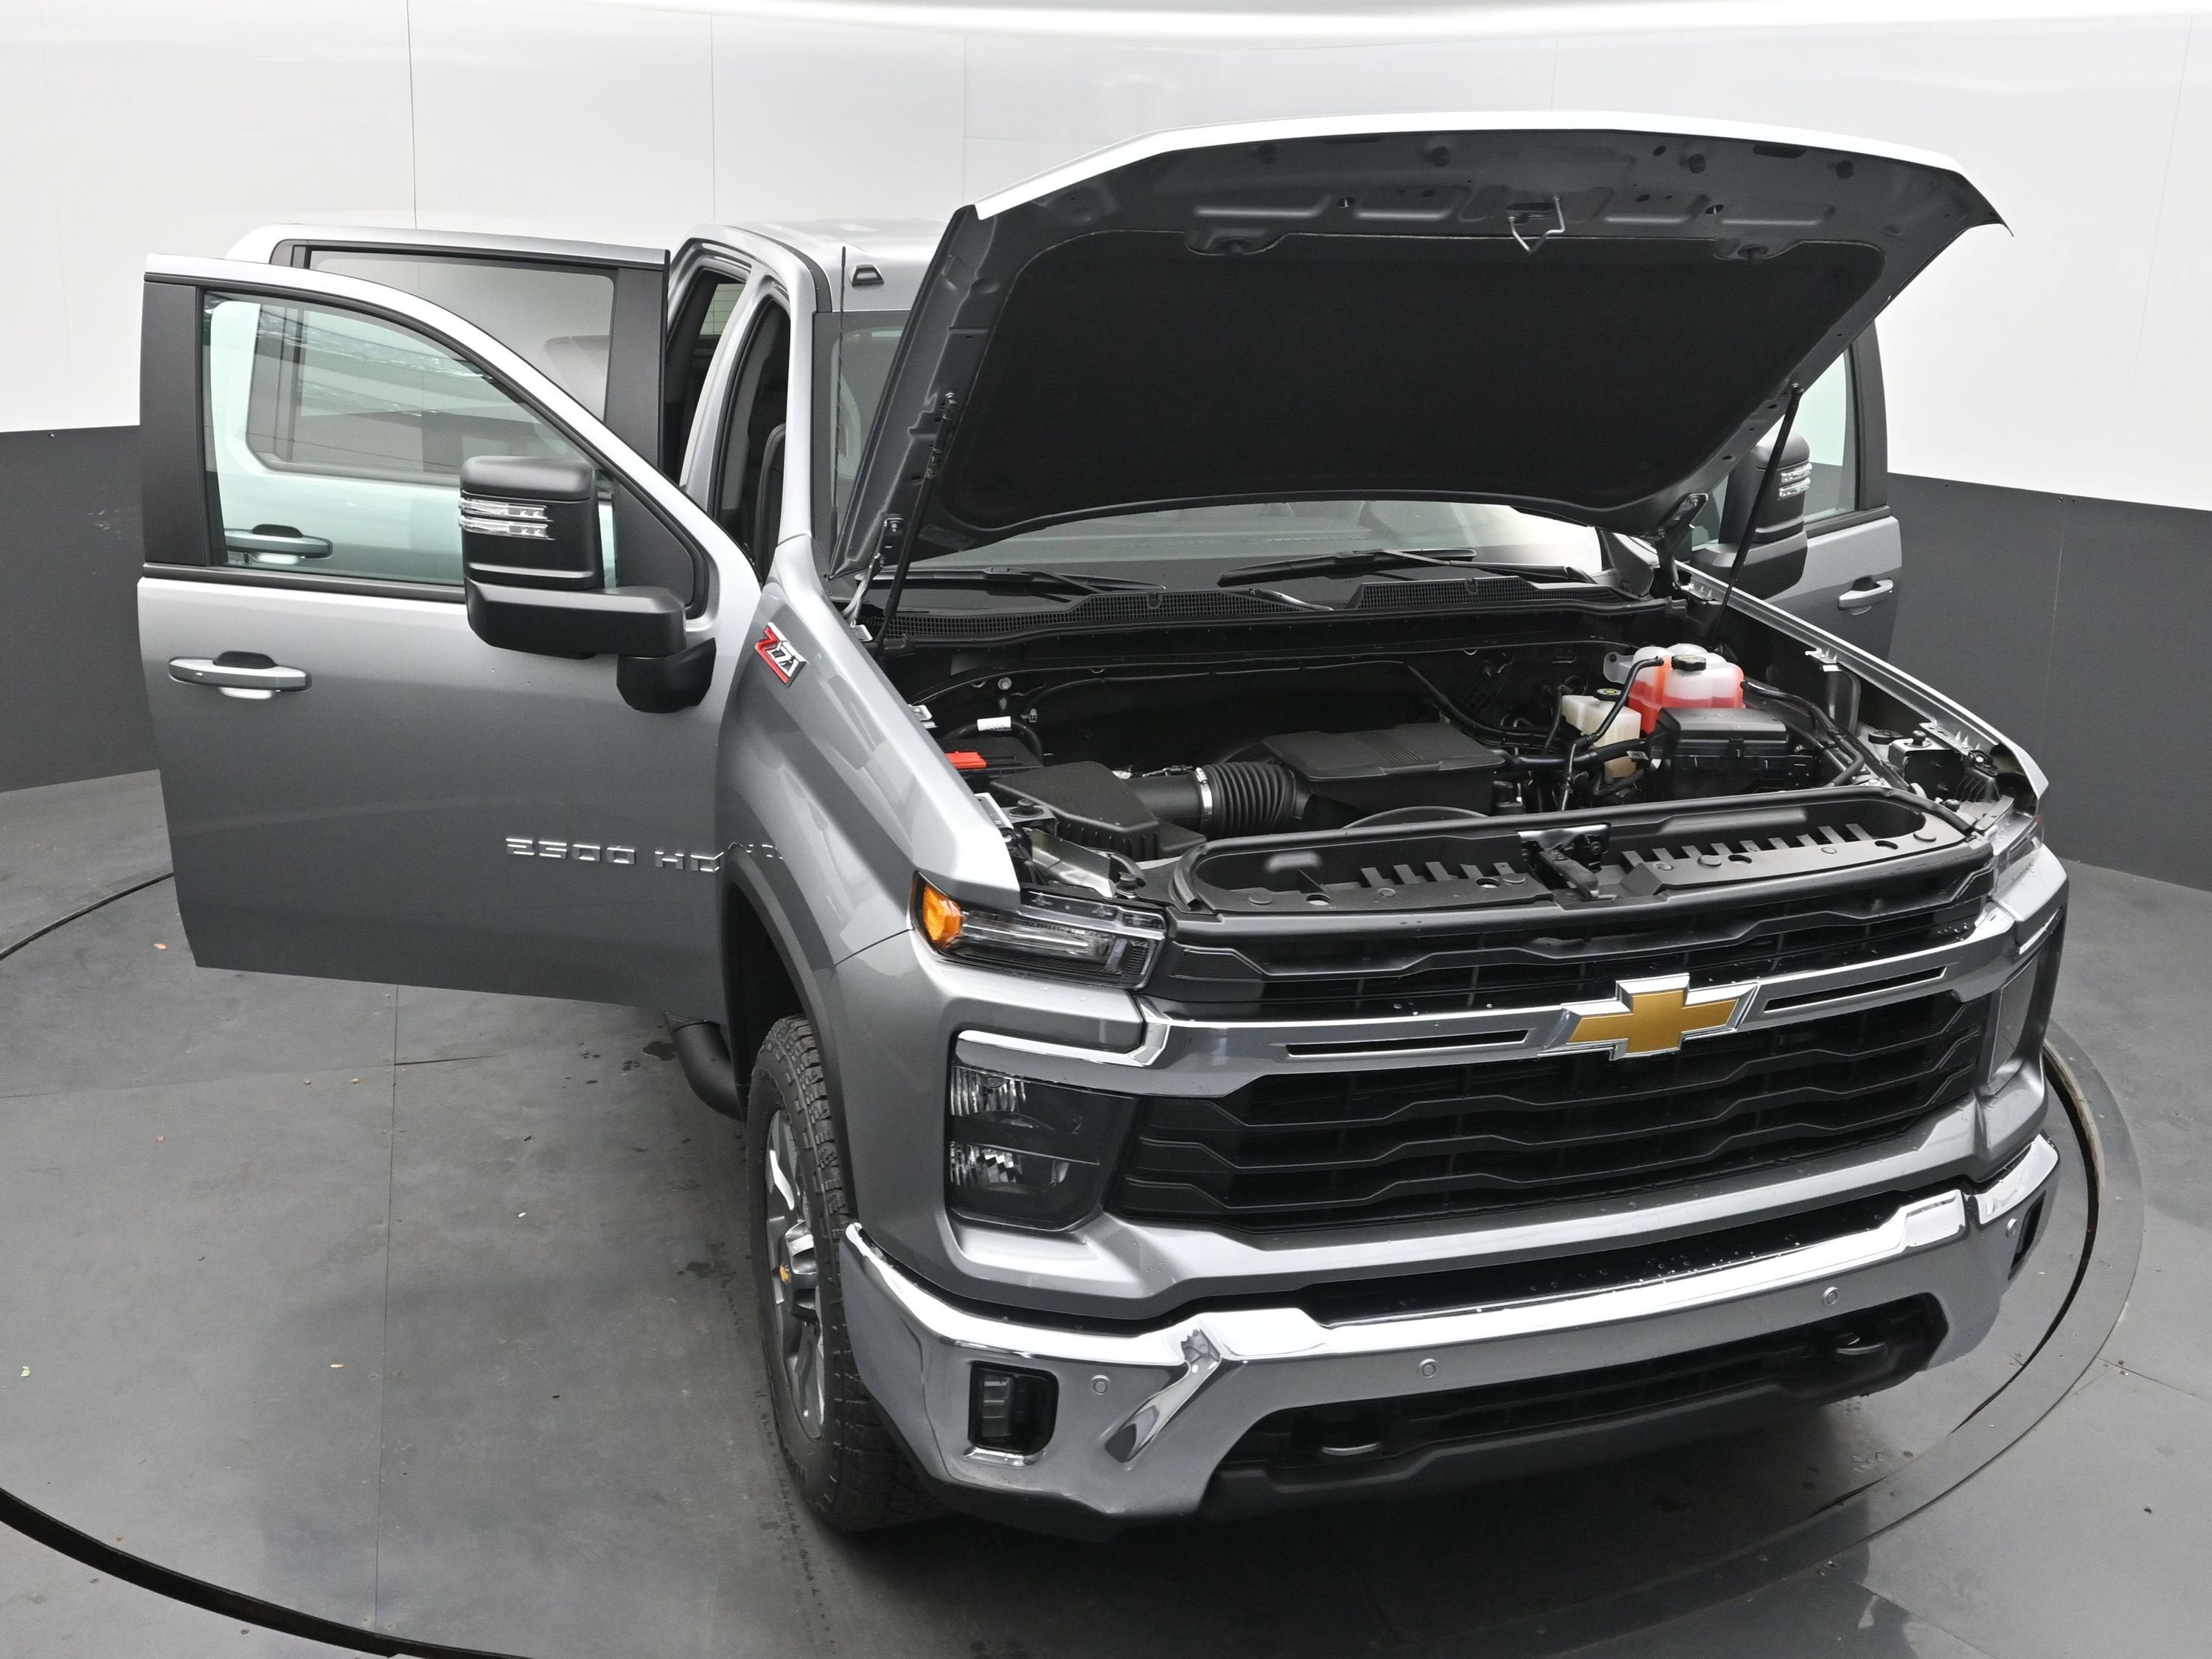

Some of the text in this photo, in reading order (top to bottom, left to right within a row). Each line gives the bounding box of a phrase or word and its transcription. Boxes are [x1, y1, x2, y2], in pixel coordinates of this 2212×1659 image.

[754, 622, 808, 687] Z71
[505, 838, 720, 872] 2500 HD
